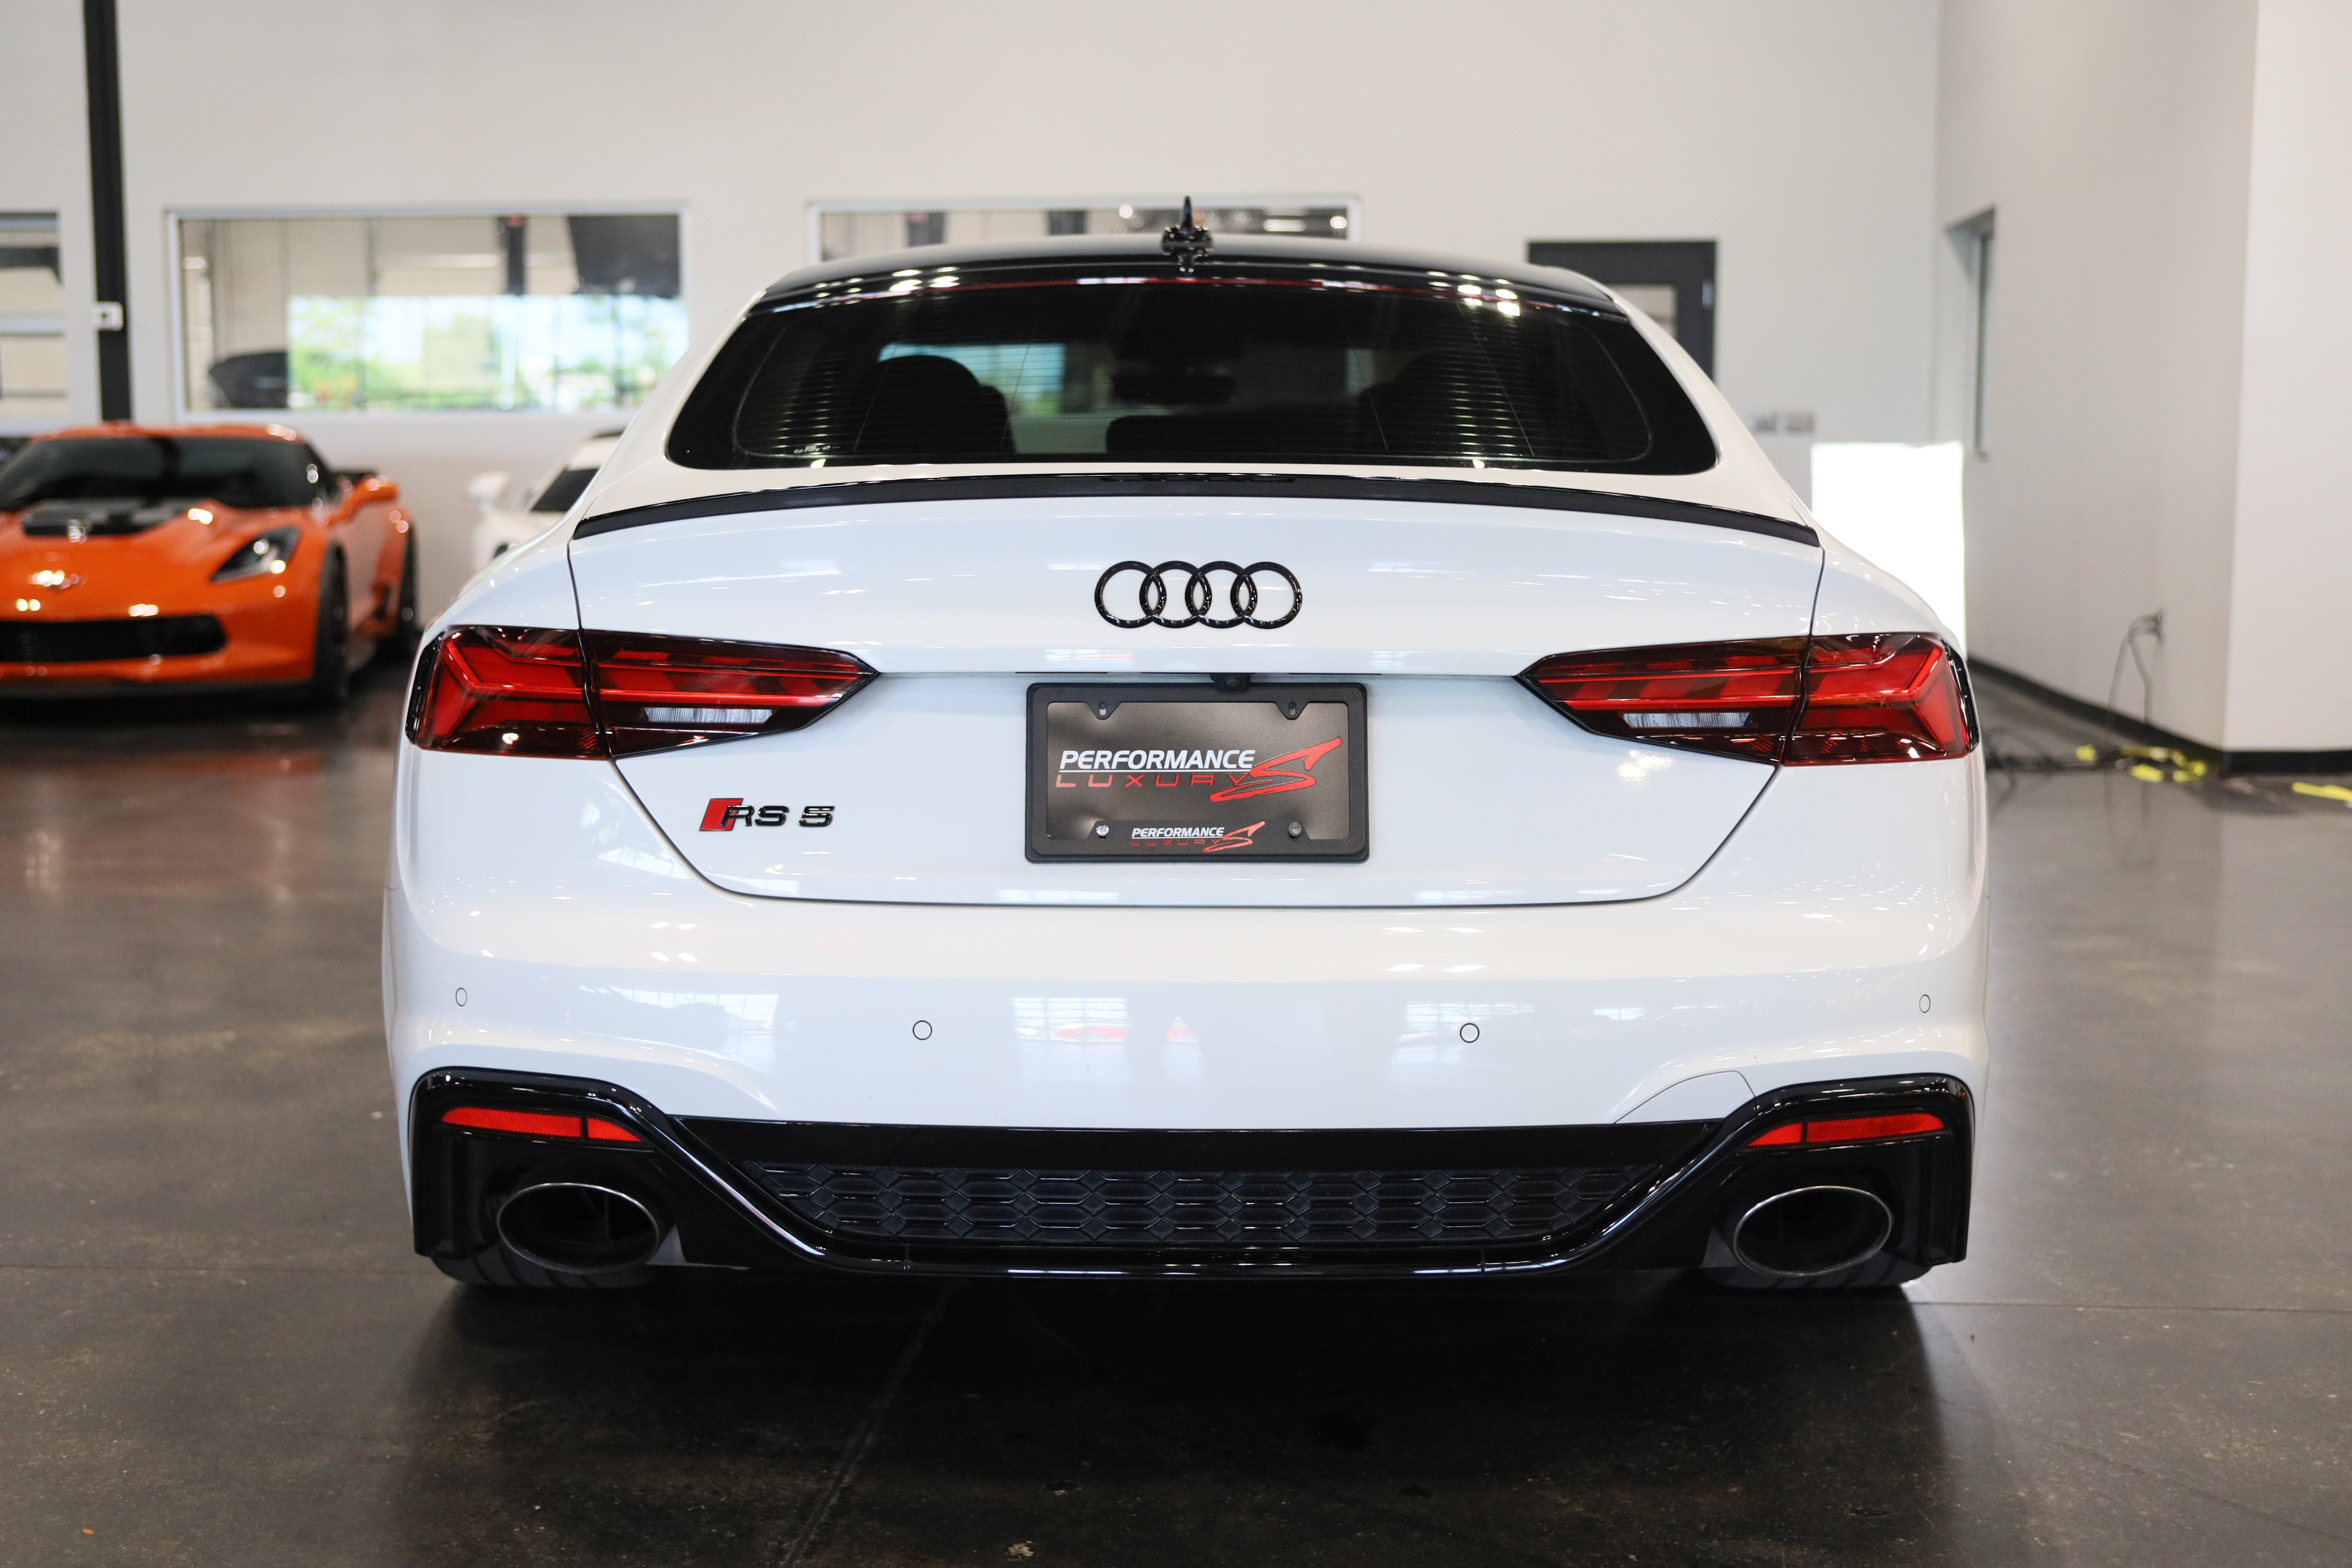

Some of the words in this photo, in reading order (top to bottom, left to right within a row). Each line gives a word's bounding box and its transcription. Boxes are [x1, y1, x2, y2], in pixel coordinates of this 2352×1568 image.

[1059, 749, 1256, 769] PERFORMANCE
[1055, 774, 1248, 787] LUXURY
[720, 805, 790, 826] RS
[798, 806, 835, 827] 5
[1131, 827, 1225, 837] PERFORMANCE
